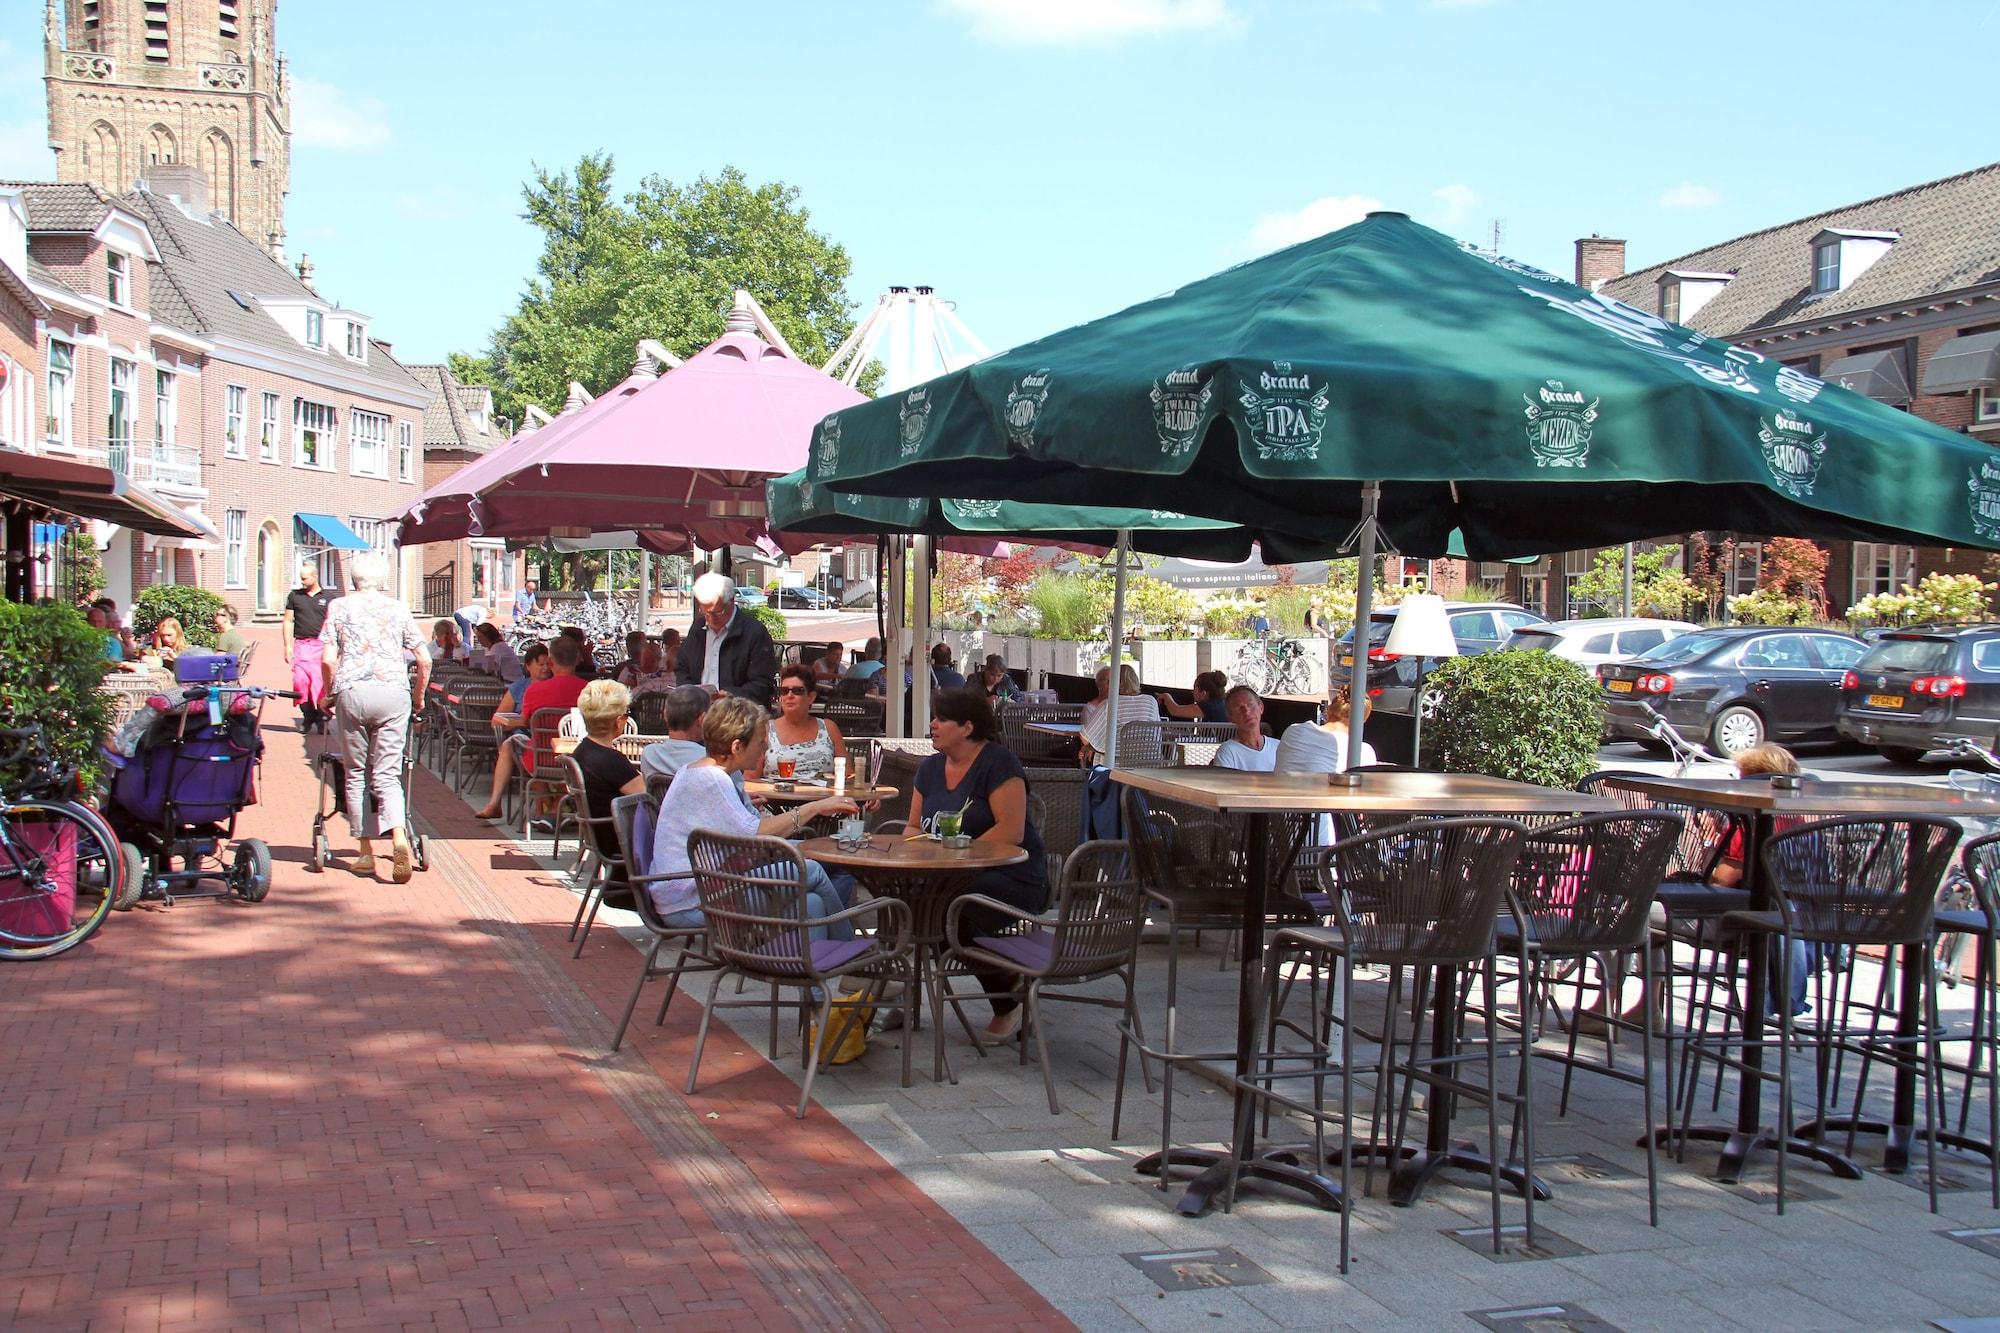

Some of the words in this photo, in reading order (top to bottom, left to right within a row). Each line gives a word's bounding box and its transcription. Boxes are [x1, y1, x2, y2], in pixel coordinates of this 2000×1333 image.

[1260, 371, 1310, 390] Brand
[1539, 387, 1585, 403] Brand
[1164, 411, 1197, 431] BLOND
[1262, 405, 1310, 437] IPA
[1775, 413, 1813, 434] Brand
[1540, 418, 1580, 448] WEIZEN
[1774, 445, 1809, 474] SAISON
[1981, 463, 2000, 480] Bra
[1979, 500, 2000, 519] BLON
[1172, 575, 1179, 583] il
[1204, 575, 1241, 584] espresso
[1244, 572, 1278, 581] italiano
